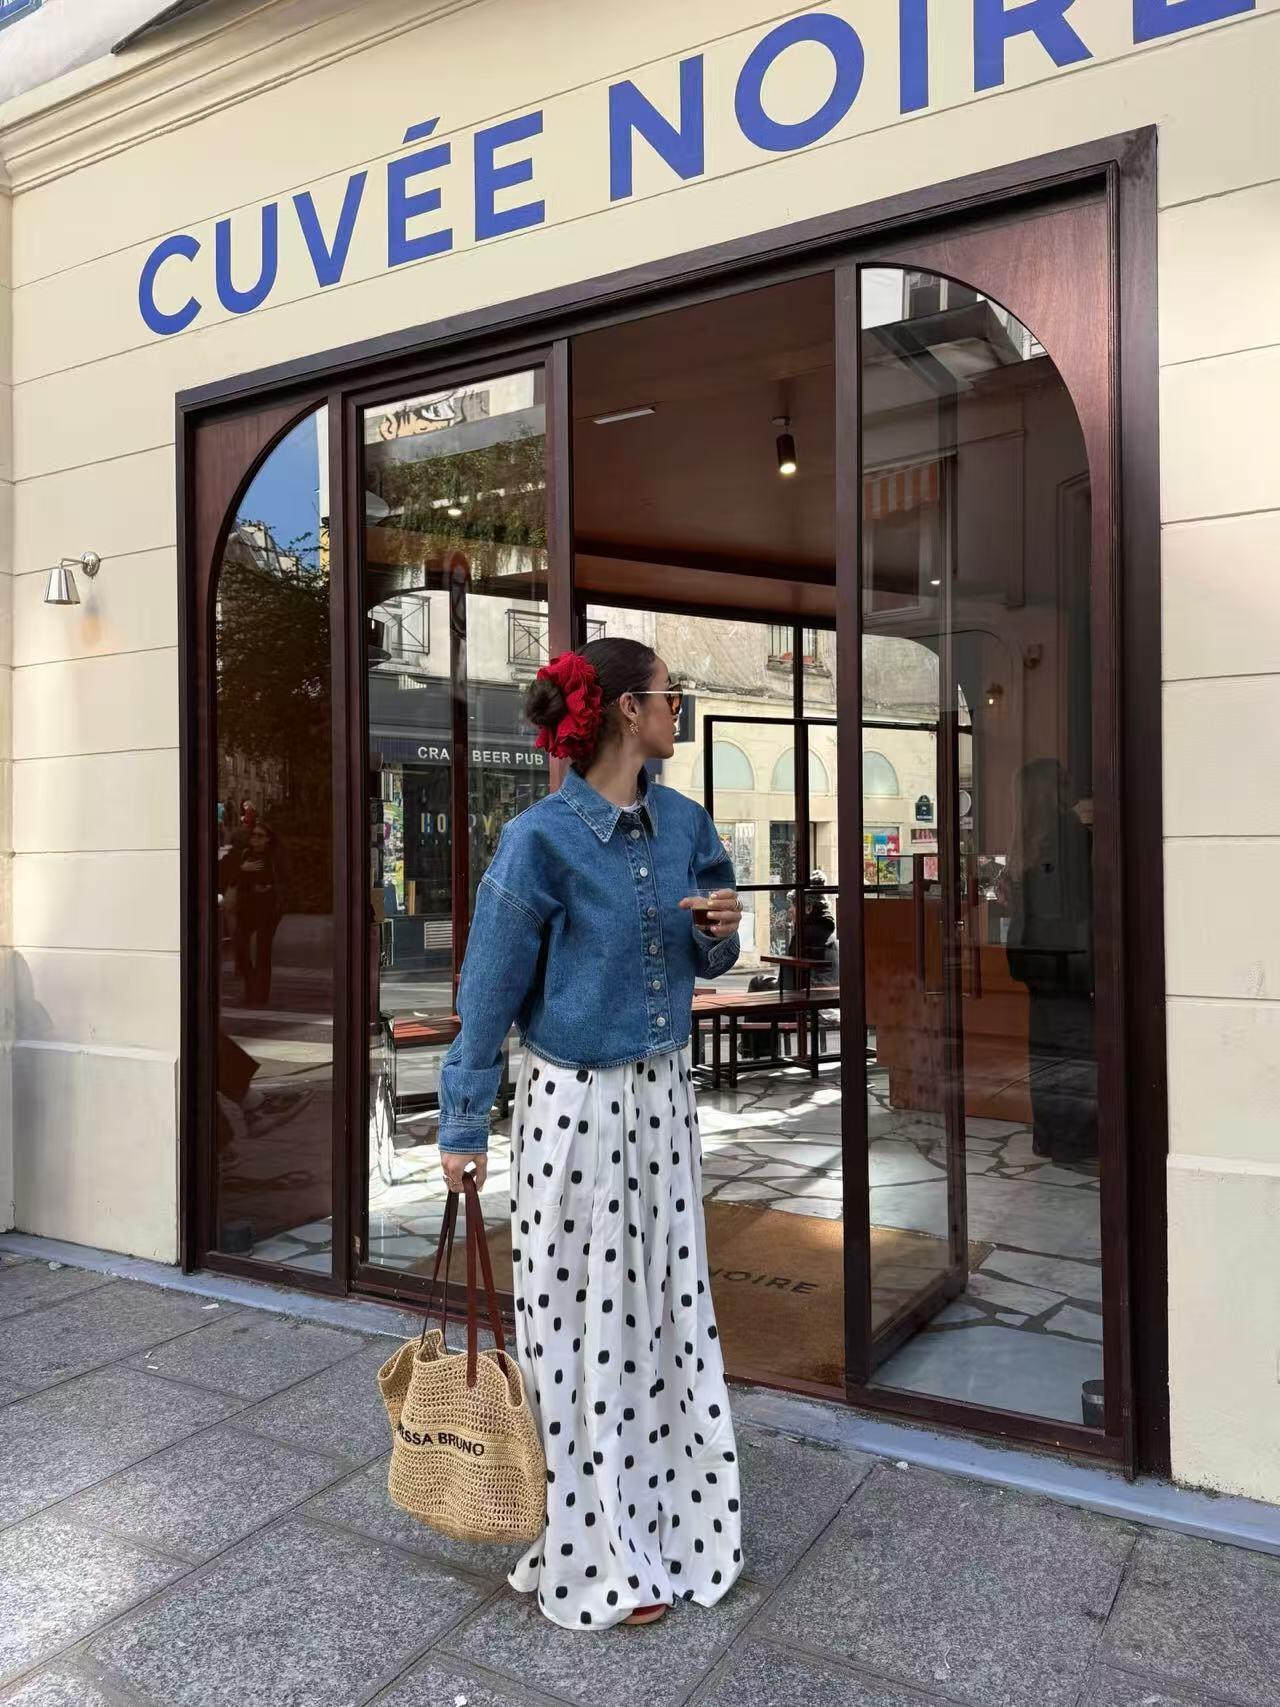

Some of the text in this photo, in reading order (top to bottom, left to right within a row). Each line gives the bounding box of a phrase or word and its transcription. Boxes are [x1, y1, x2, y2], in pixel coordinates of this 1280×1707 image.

[138, 0, 1257, 335] CUVÉE NOIR
[417, 746, 544, 765] CRA BEER PUB
[437, 1432, 485, 1457] BRUNO
